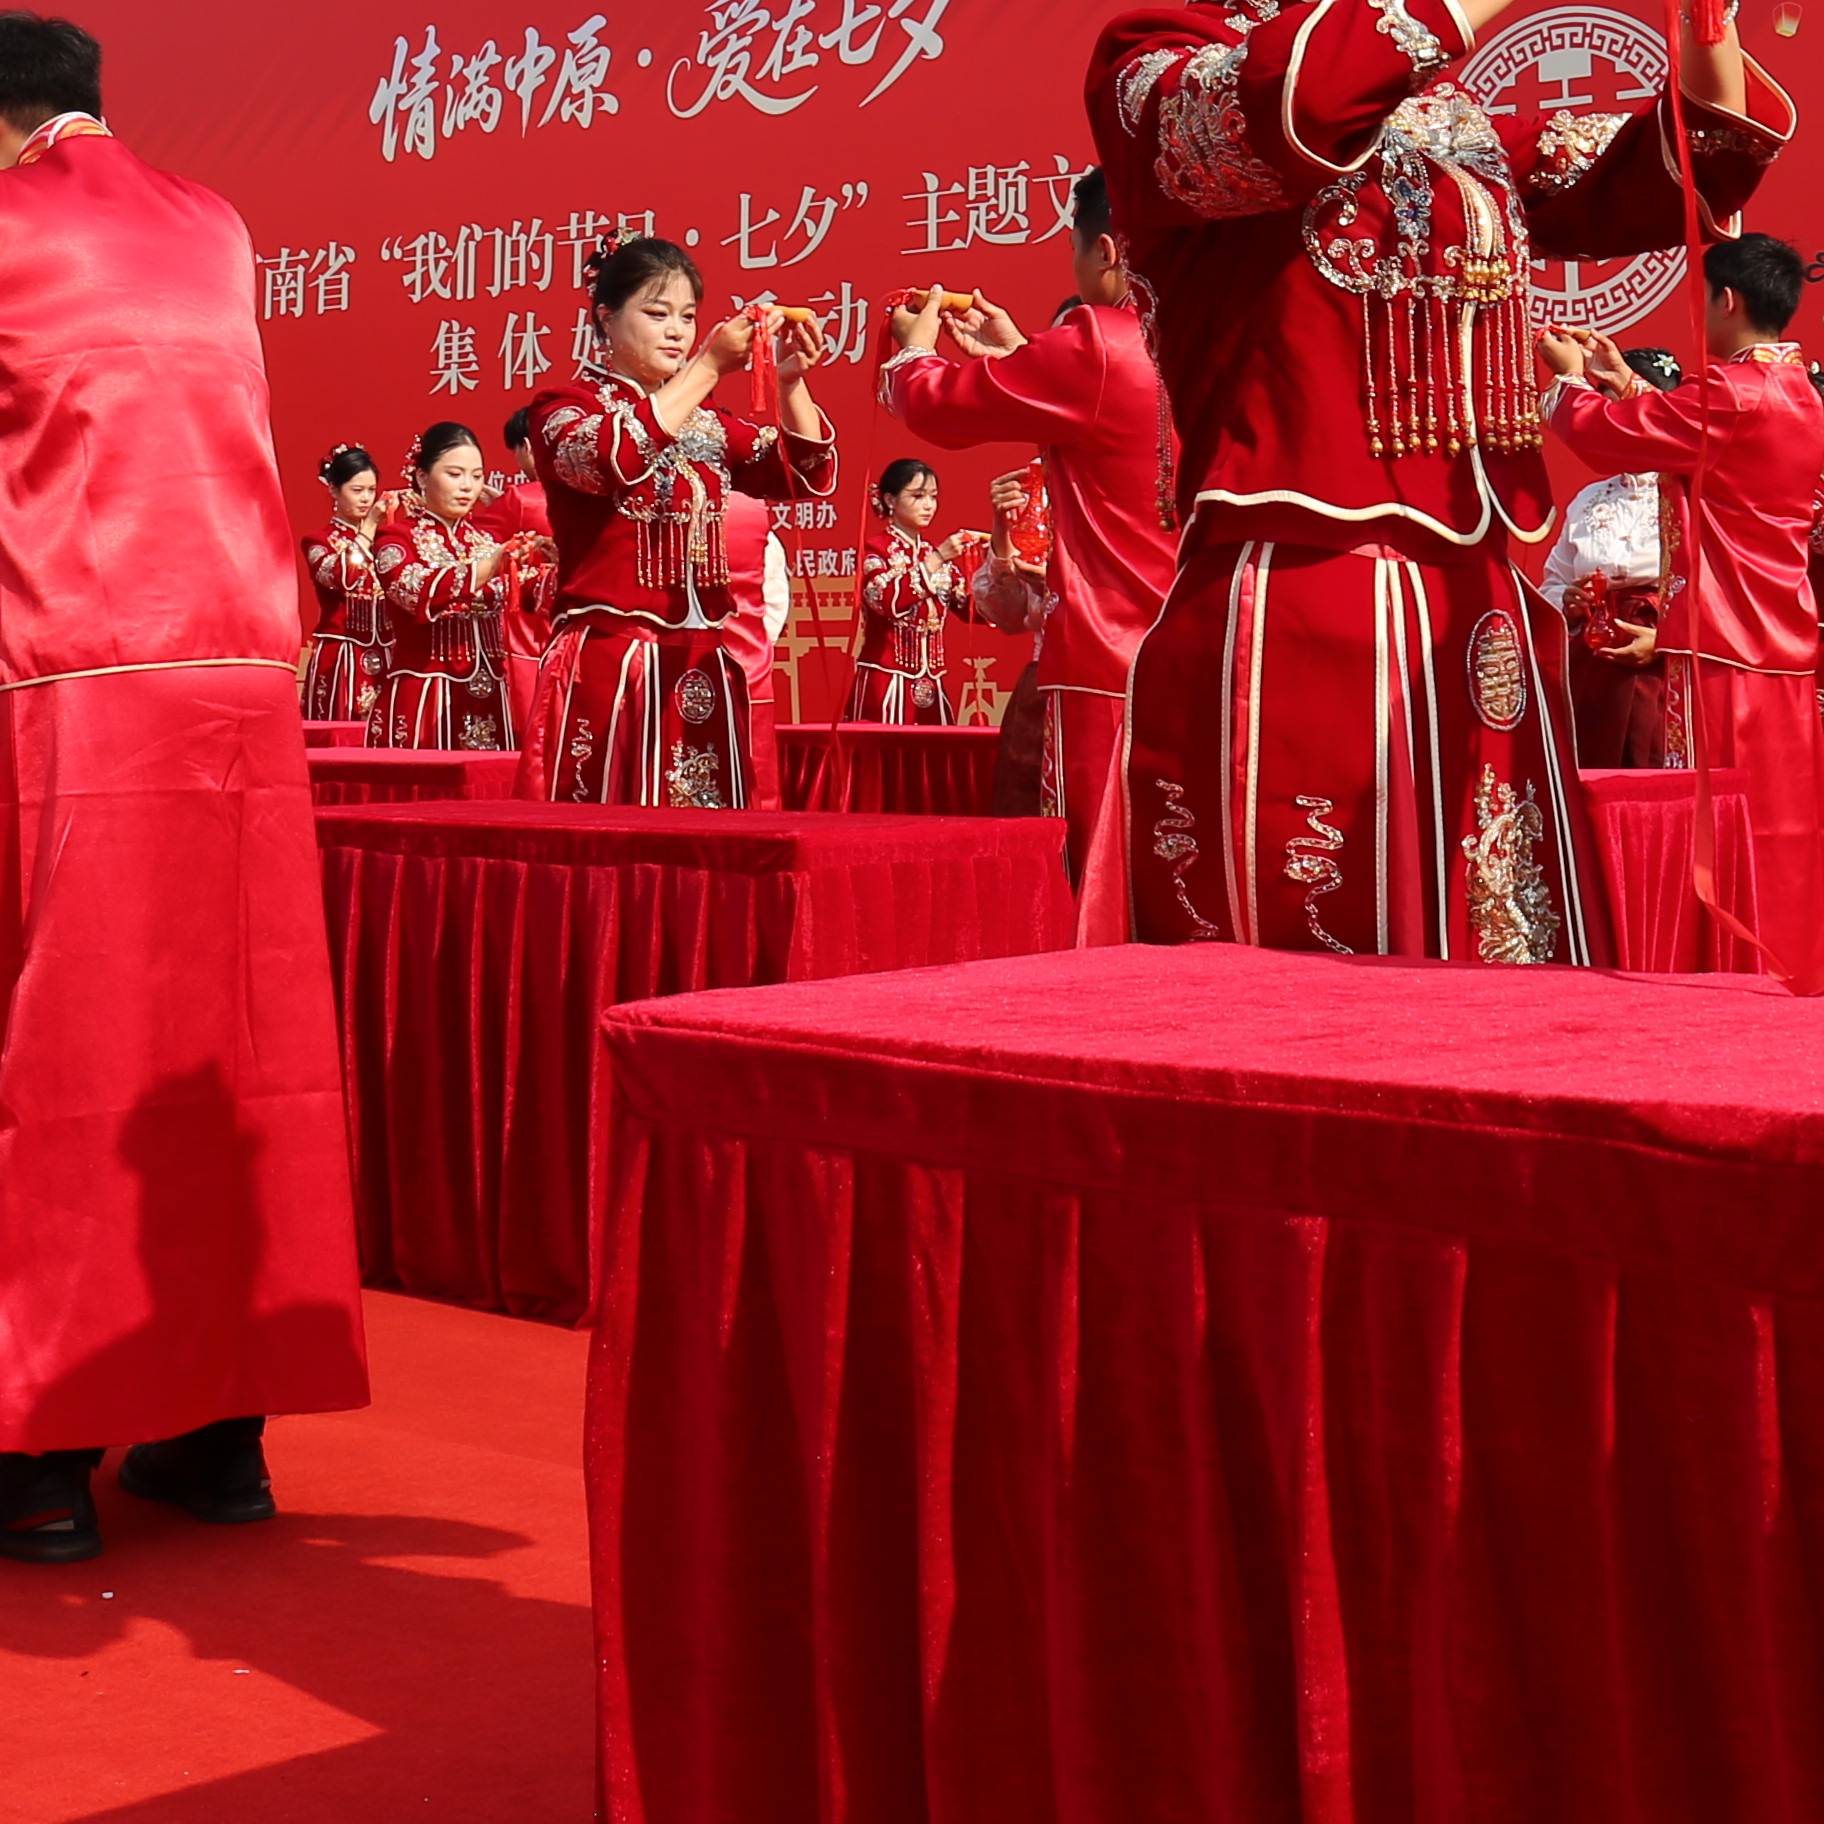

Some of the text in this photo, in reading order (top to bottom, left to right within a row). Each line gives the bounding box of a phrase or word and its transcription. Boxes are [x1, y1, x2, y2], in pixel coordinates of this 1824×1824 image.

[766, 500, 837, 530] 文明办
[784, 547, 856, 577] 民政府
